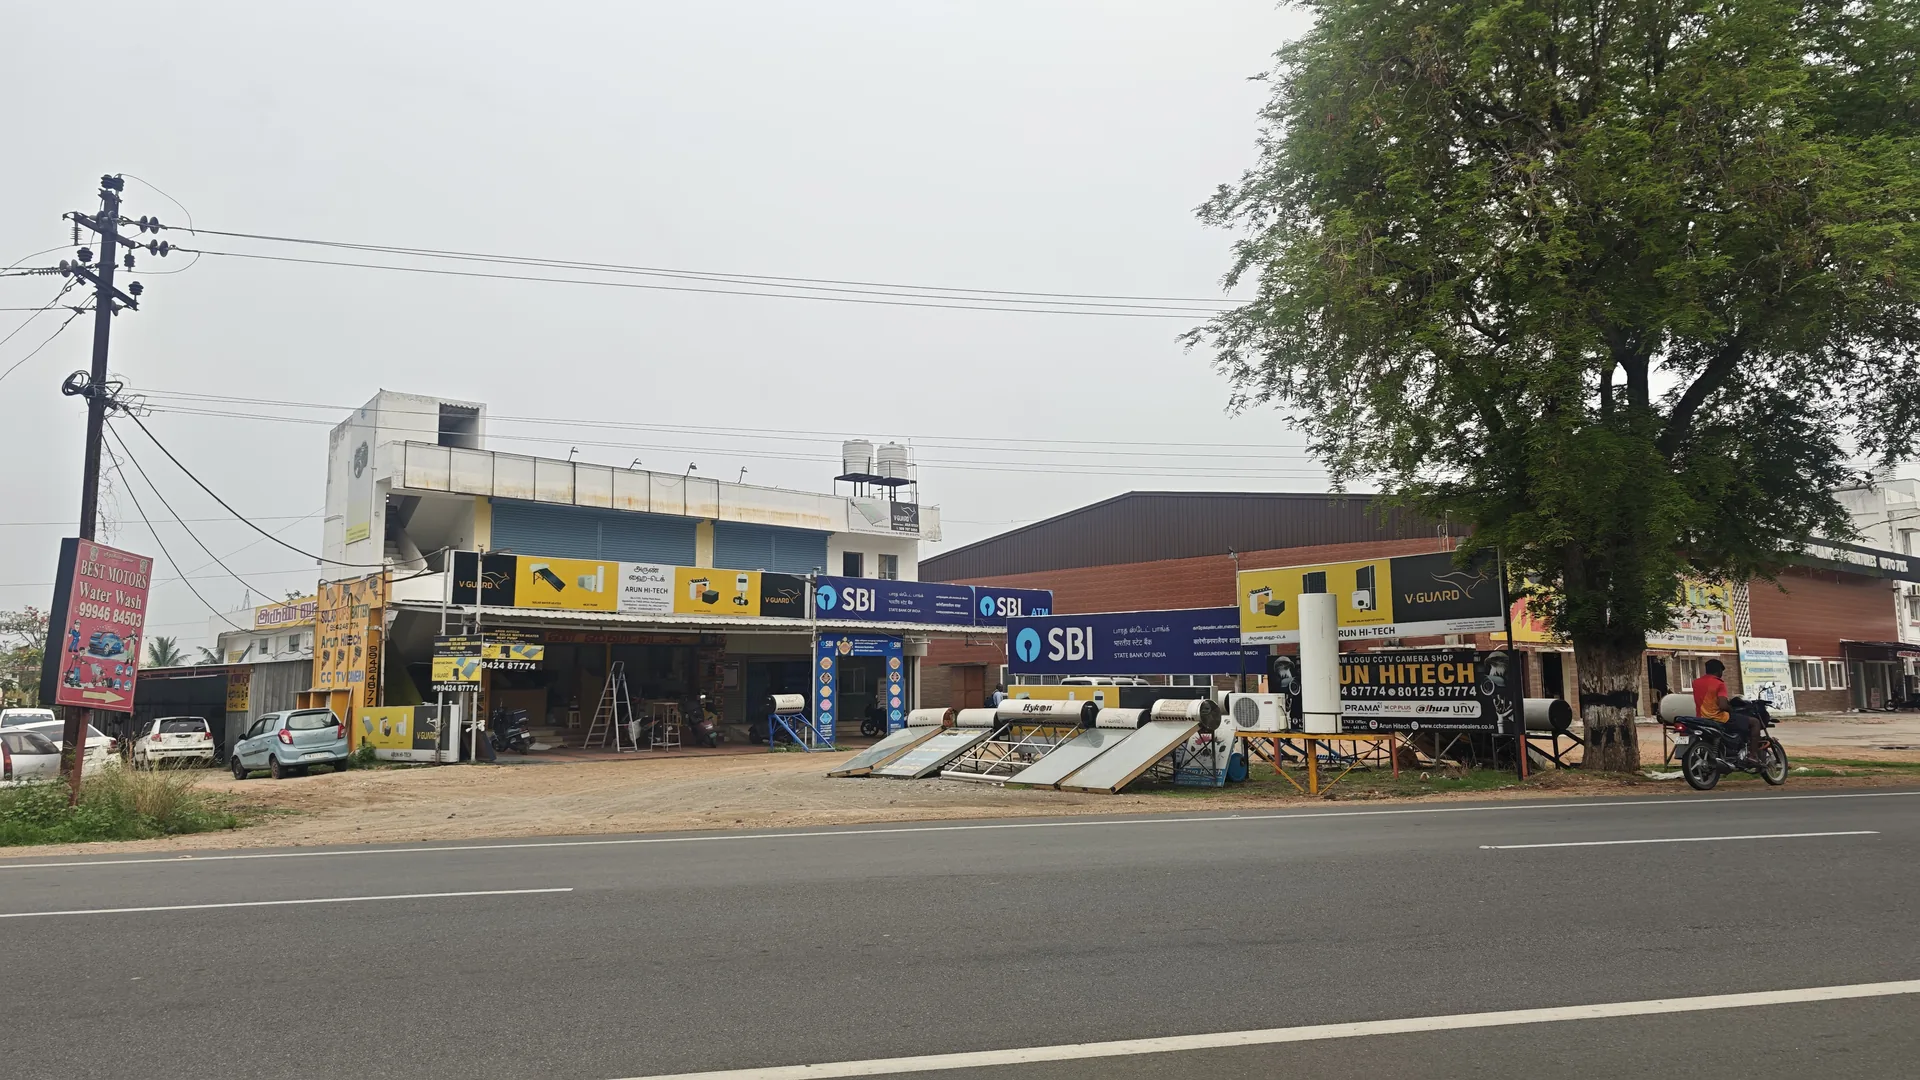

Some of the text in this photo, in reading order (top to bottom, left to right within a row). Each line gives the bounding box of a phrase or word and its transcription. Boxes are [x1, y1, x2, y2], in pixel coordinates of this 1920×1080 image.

[80, 560, 147, 589] BEST MOTORS
[634, 566, 659, 574] அருண்
[459, 580, 492, 589] V-GURD
[80, 582, 141, 610] Water Wash
[842, 588, 875, 612] SBI
[1405, 590, 1459, 604] V-GUARD
[79, 602, 142, 627] 99946 84503
[258, 602, 297, 624] அருண்
[996, 597, 1021, 616] SBI
[1031, 608, 1048, 616] ATM
[1338, 627, 1395, 637] RUN HI-TECH
[321, 636, 339, 648] Arun
[1048, 626, 1093, 661] SBI
[321, 672, 331, 683] CC
[336, 671, 346, 682] TV
[367, 646, 377, 707] 99424877
[1340, 663, 1475, 684] UN HITECH
[1351, 687, 1386, 696] 87774
[1398, 687, 1434, 696] 80125
[1438, 686, 1476, 696] 87774
[1023, 704, 1052, 712] Hykon
